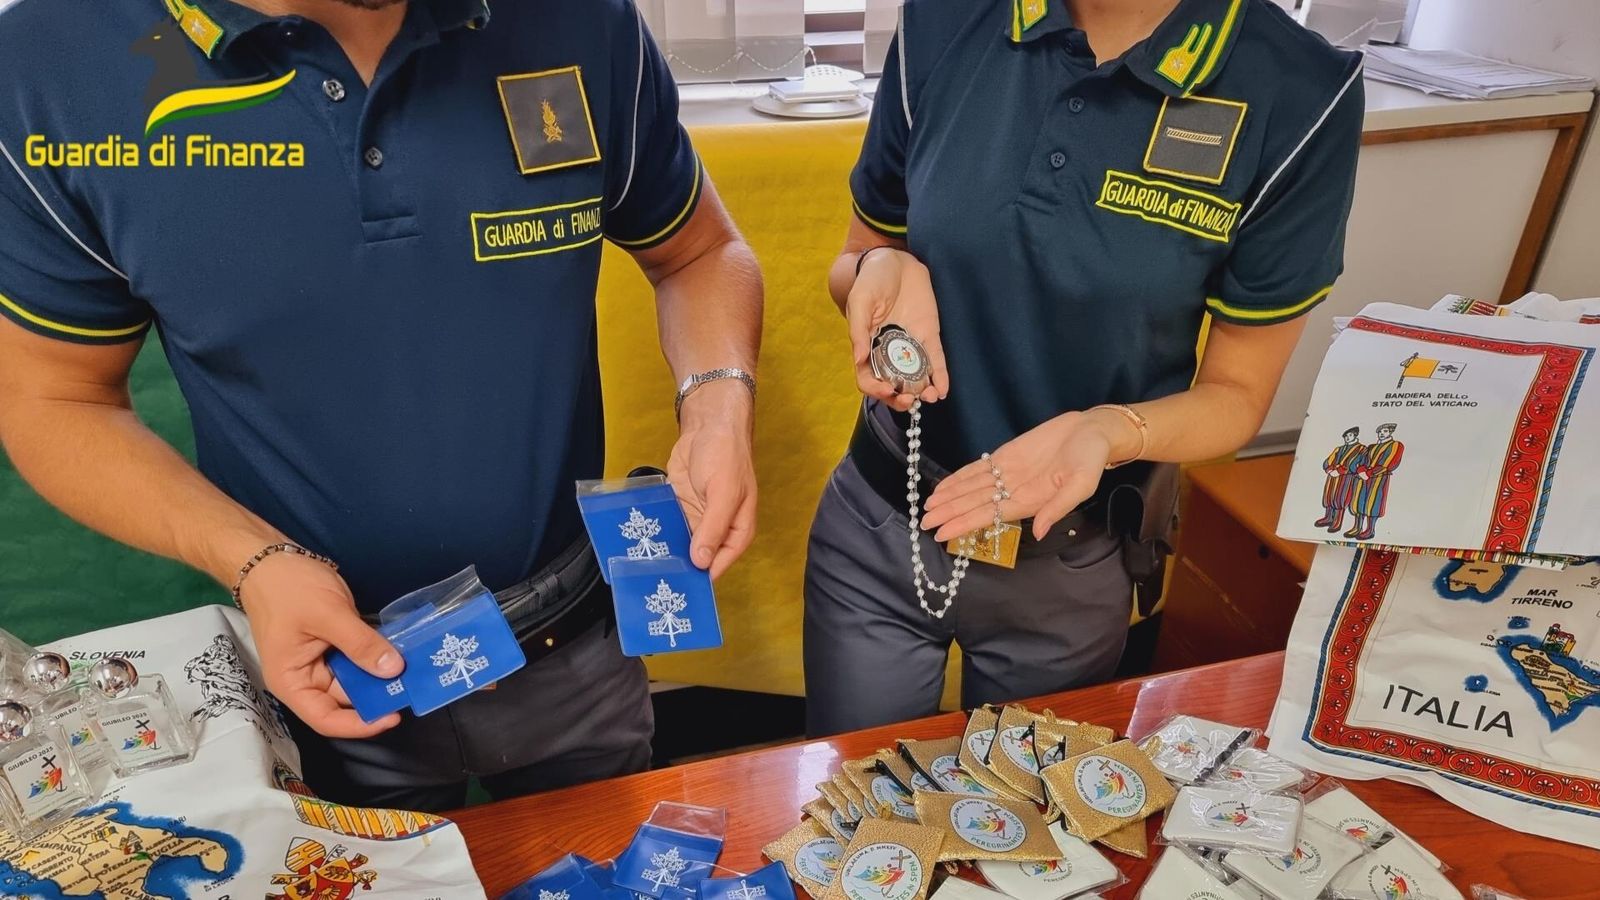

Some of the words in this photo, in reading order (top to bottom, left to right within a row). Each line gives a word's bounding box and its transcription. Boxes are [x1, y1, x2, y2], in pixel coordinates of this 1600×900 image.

[1106, 181, 1170, 214] GUARDIA
[1169, 198, 1184, 219] di
[1182, 200, 1233, 233] FINANZA
[484, 220, 547, 248] GUARDIA
[553, 218, 565, 239] di
[571, 207, 600, 236] FINANZ
[1527, 589, 1558, 597] MAR
[1511, 598, 1573, 609] TIRRENO
[69, 650, 146, 660] SLOVENIA
[55, 707, 77, 720] UBILEO
[102, 716, 131, 726] GIUBILEO
[132, 712, 147, 720] 2025
[1383, 685, 1513, 738] ITALIA
[8, 754, 38, 772] GIUBILEO
[38, 746, 54, 757] 2025
[32, 842, 81, 854] CAMPANIA
[150, 839, 184, 858] PUGLIA
[971, 830, 1024, 848] PEREGRINANTES
[32, 851, 65, 870] CASERTA
[95, 857, 135, 877] POTENZA
[799, 858, 831, 883] PEREGRINAN
